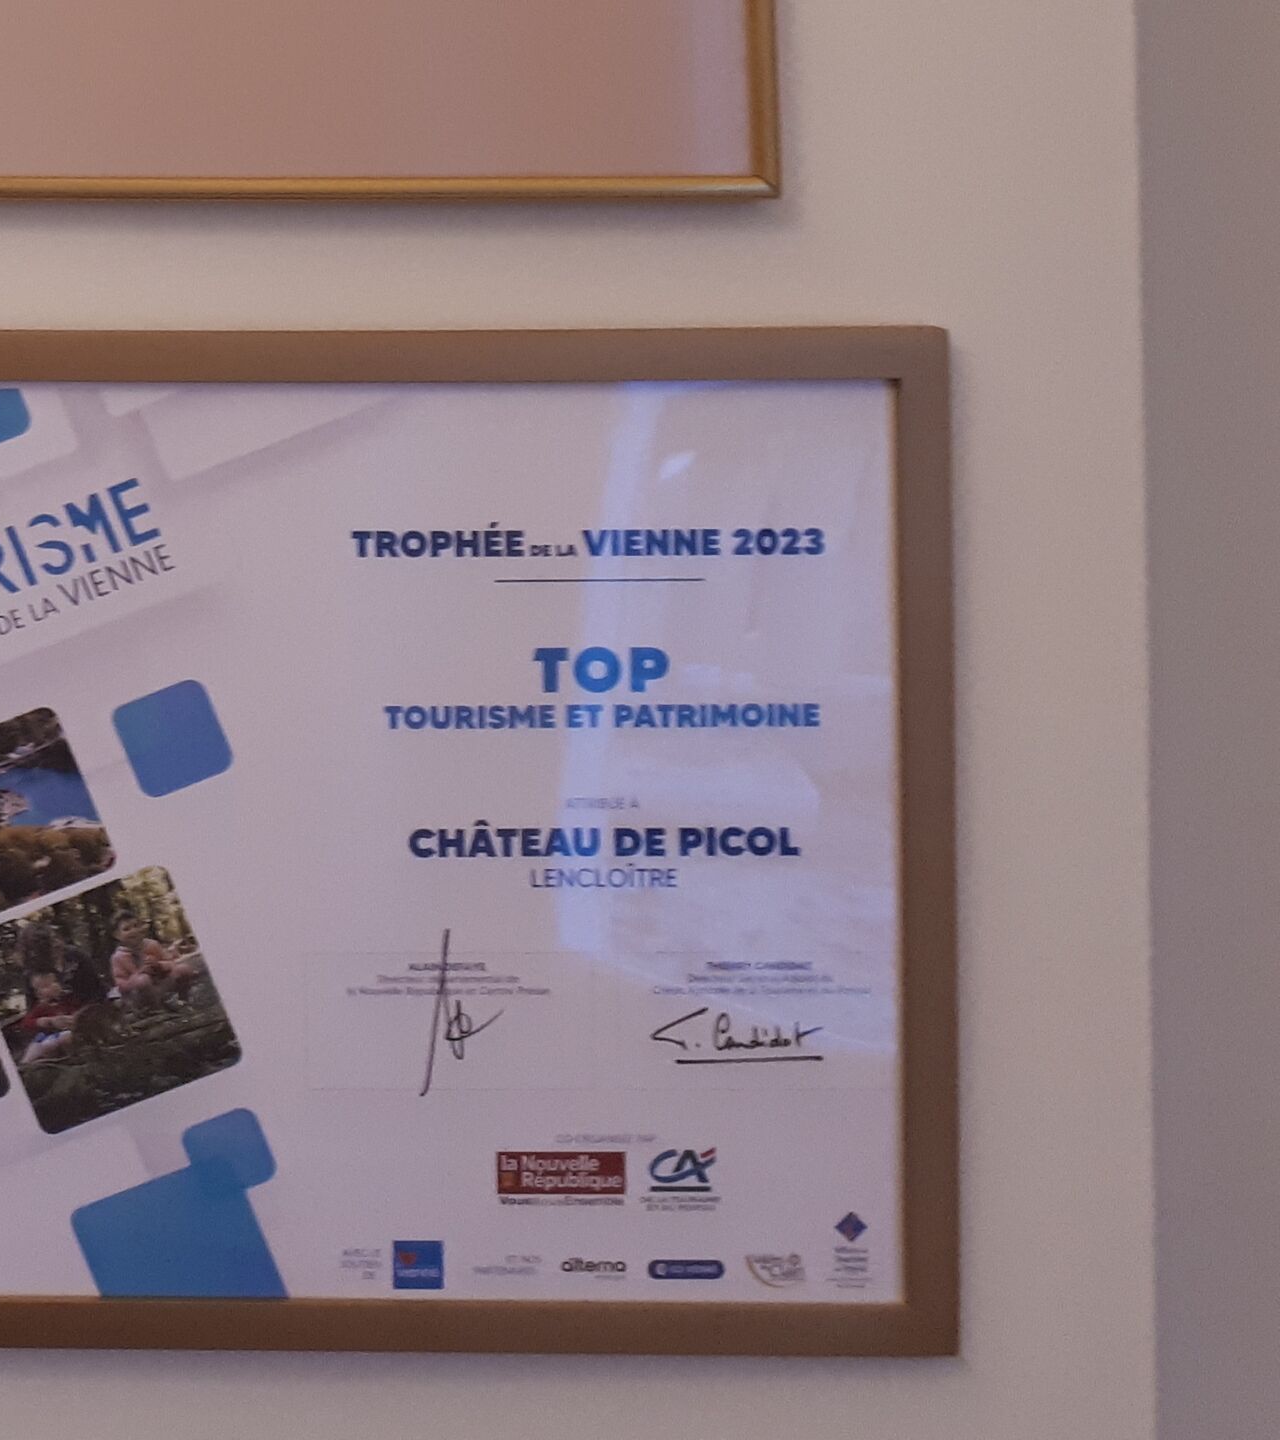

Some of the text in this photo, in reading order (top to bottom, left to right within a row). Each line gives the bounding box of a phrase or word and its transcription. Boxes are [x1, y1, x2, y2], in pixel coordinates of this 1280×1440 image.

[352, 522, 825, 558] TROPHÉE DE LA VIENNE 2023
[31, 597, 60, 623] LA
[57, 544, 176, 607] VIENNE
[533, 647, 670, 693] TOP
[384, 703, 820, 730] TOURISME ET PATRIMOINE
[408, 821, 801, 857] CHÂTEAU DE PICOL
[530, 863, 677, 888] LENCLOÎTRE
[520, 1155, 600, 1172] Nouvelle
